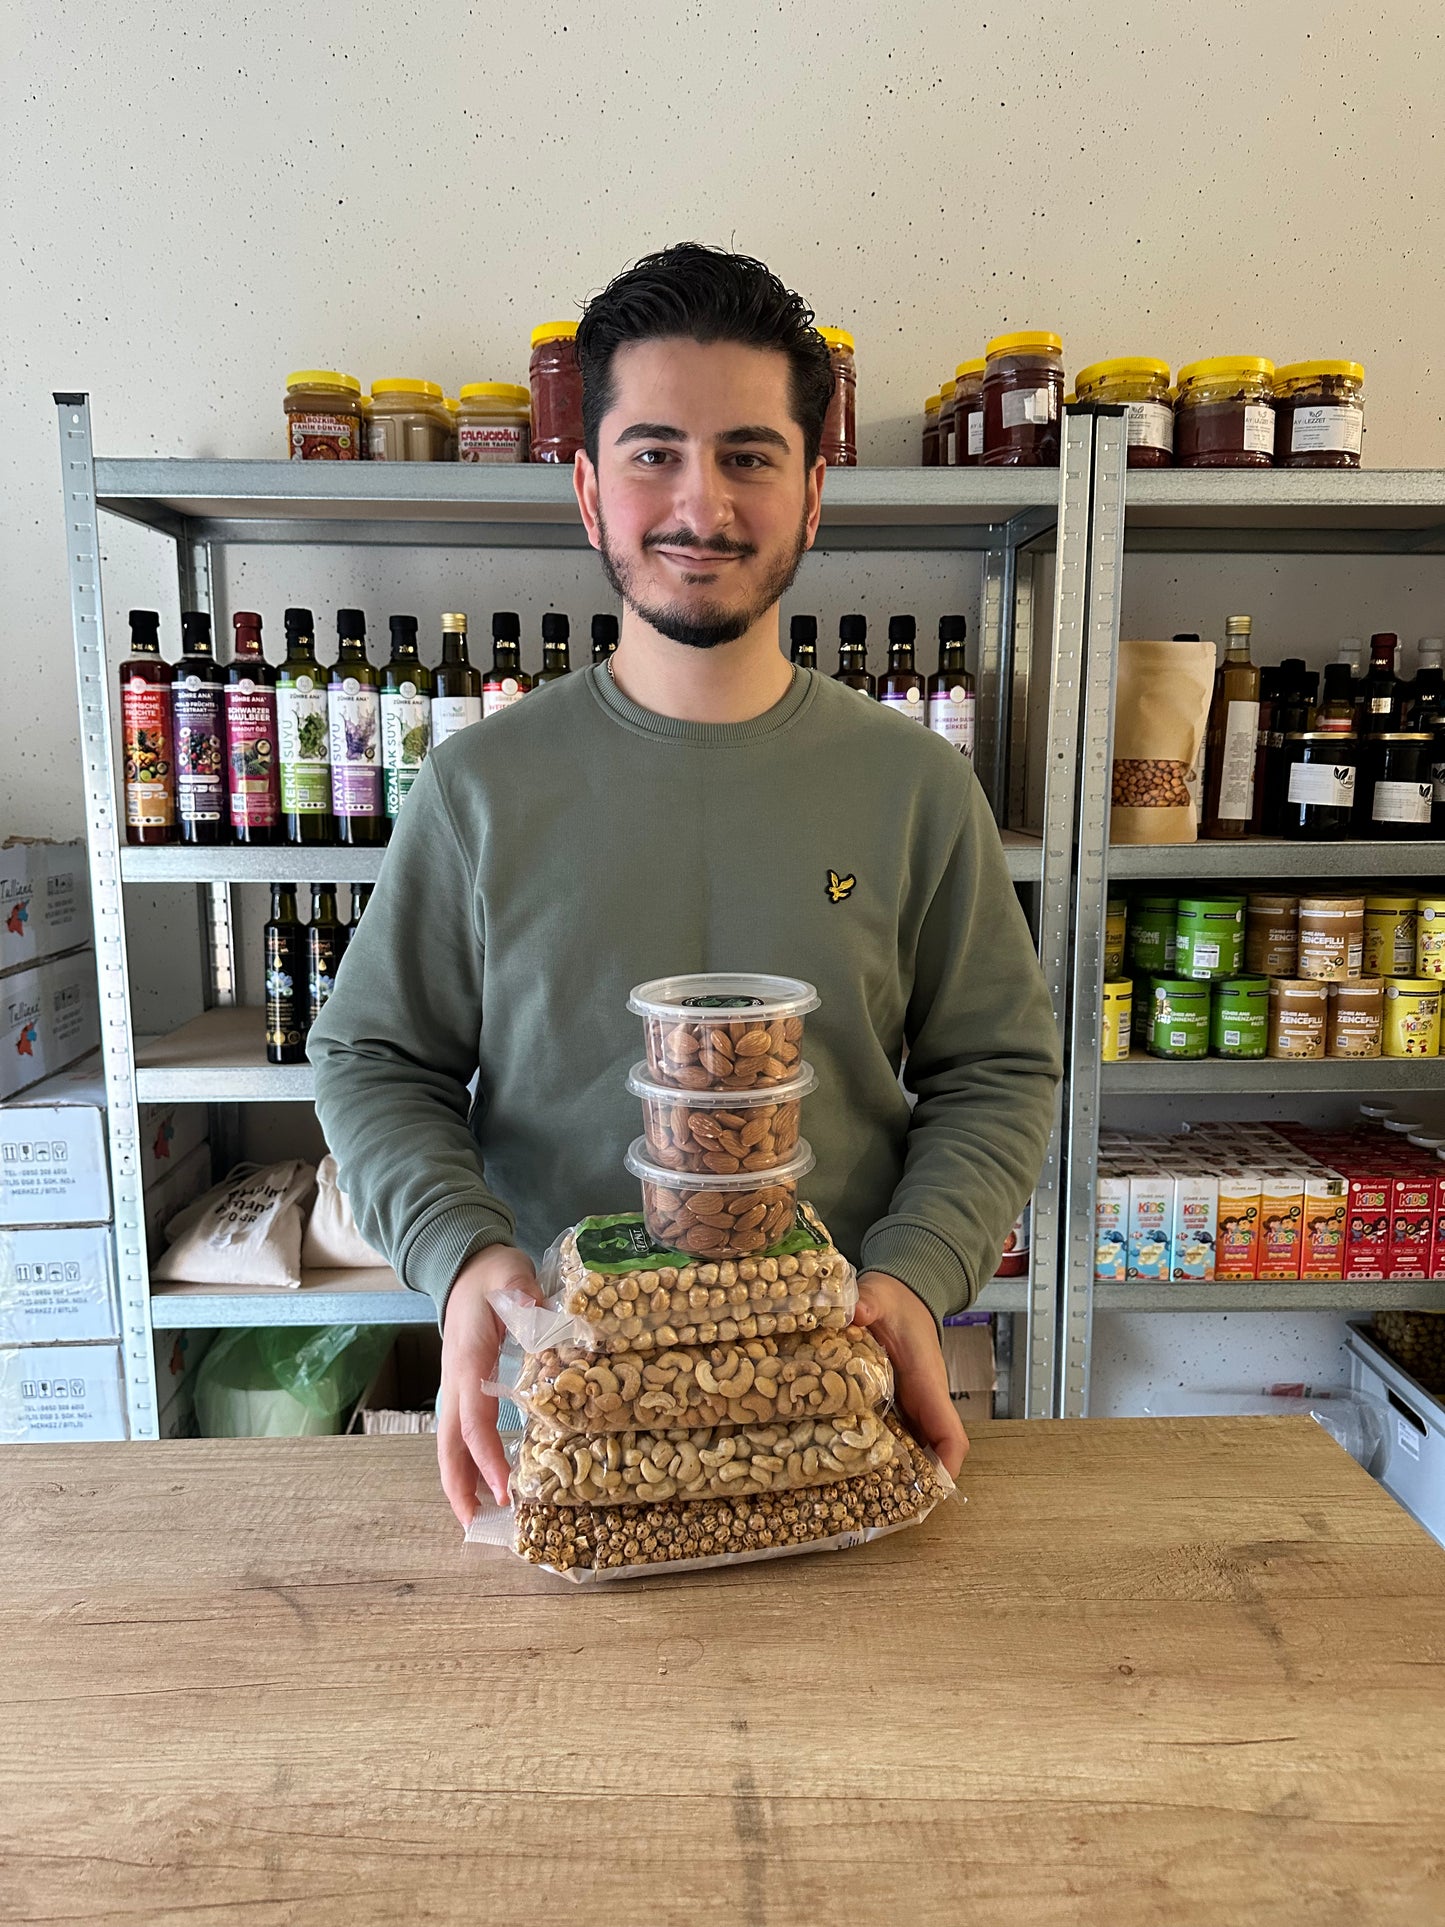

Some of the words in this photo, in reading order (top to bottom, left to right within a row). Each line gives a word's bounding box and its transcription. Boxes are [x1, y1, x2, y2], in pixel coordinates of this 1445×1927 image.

[307, 416, 335, 424] BOZKIR
[1304, 417, 1326, 425] LEZZET
[461, 429, 519, 442] KALAYCIOĞLU
[228, 706, 270, 714] SCHWARZER
[387, 712, 397, 746] SUYU
[282, 720, 294, 758] SUYU
[332, 723, 342, 761] SUYU
[333, 765, 344, 811] HAYIT
[388, 749, 399, 814] KOZALAK
[1355, 1192, 1386, 1207] KiDS
[1398, 1192, 1429, 1207] KiDS
[1138, 1201, 1166, 1214] KiDS
[1183, 1203, 1209, 1216] KiDS
